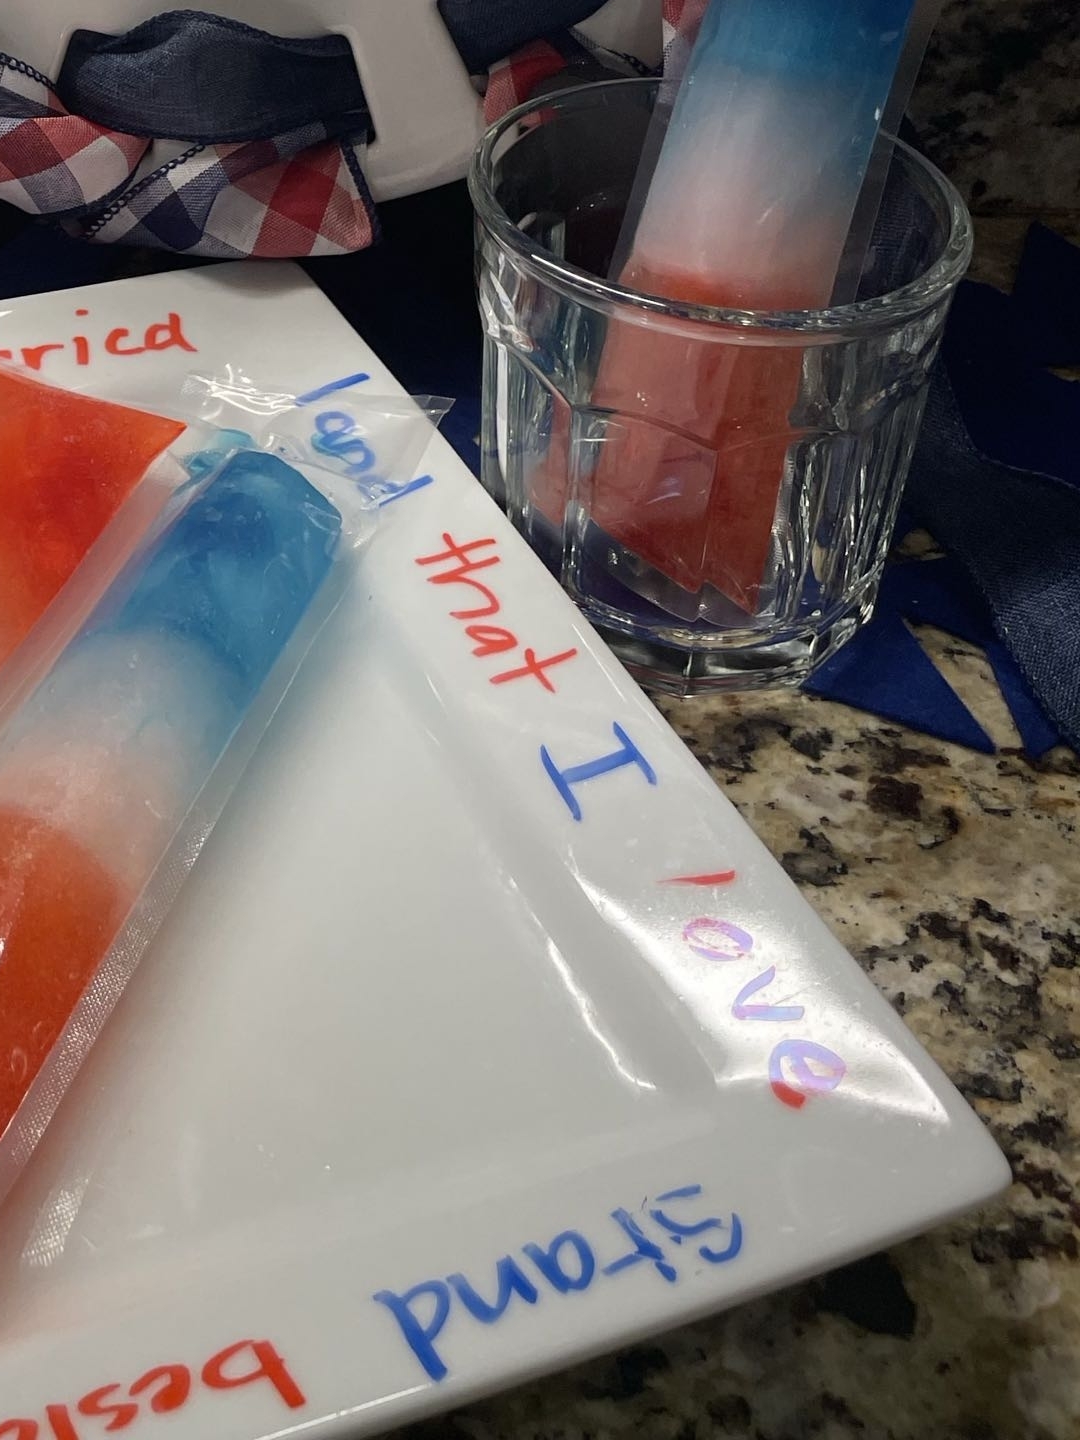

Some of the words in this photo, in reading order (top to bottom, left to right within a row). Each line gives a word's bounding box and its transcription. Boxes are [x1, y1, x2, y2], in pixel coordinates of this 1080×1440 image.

[415, 532, 578, 694] that
[540, 721, 658, 822] I
[655, 870, 848, 1110] love
[374, 1184, 743, 1382] stand
